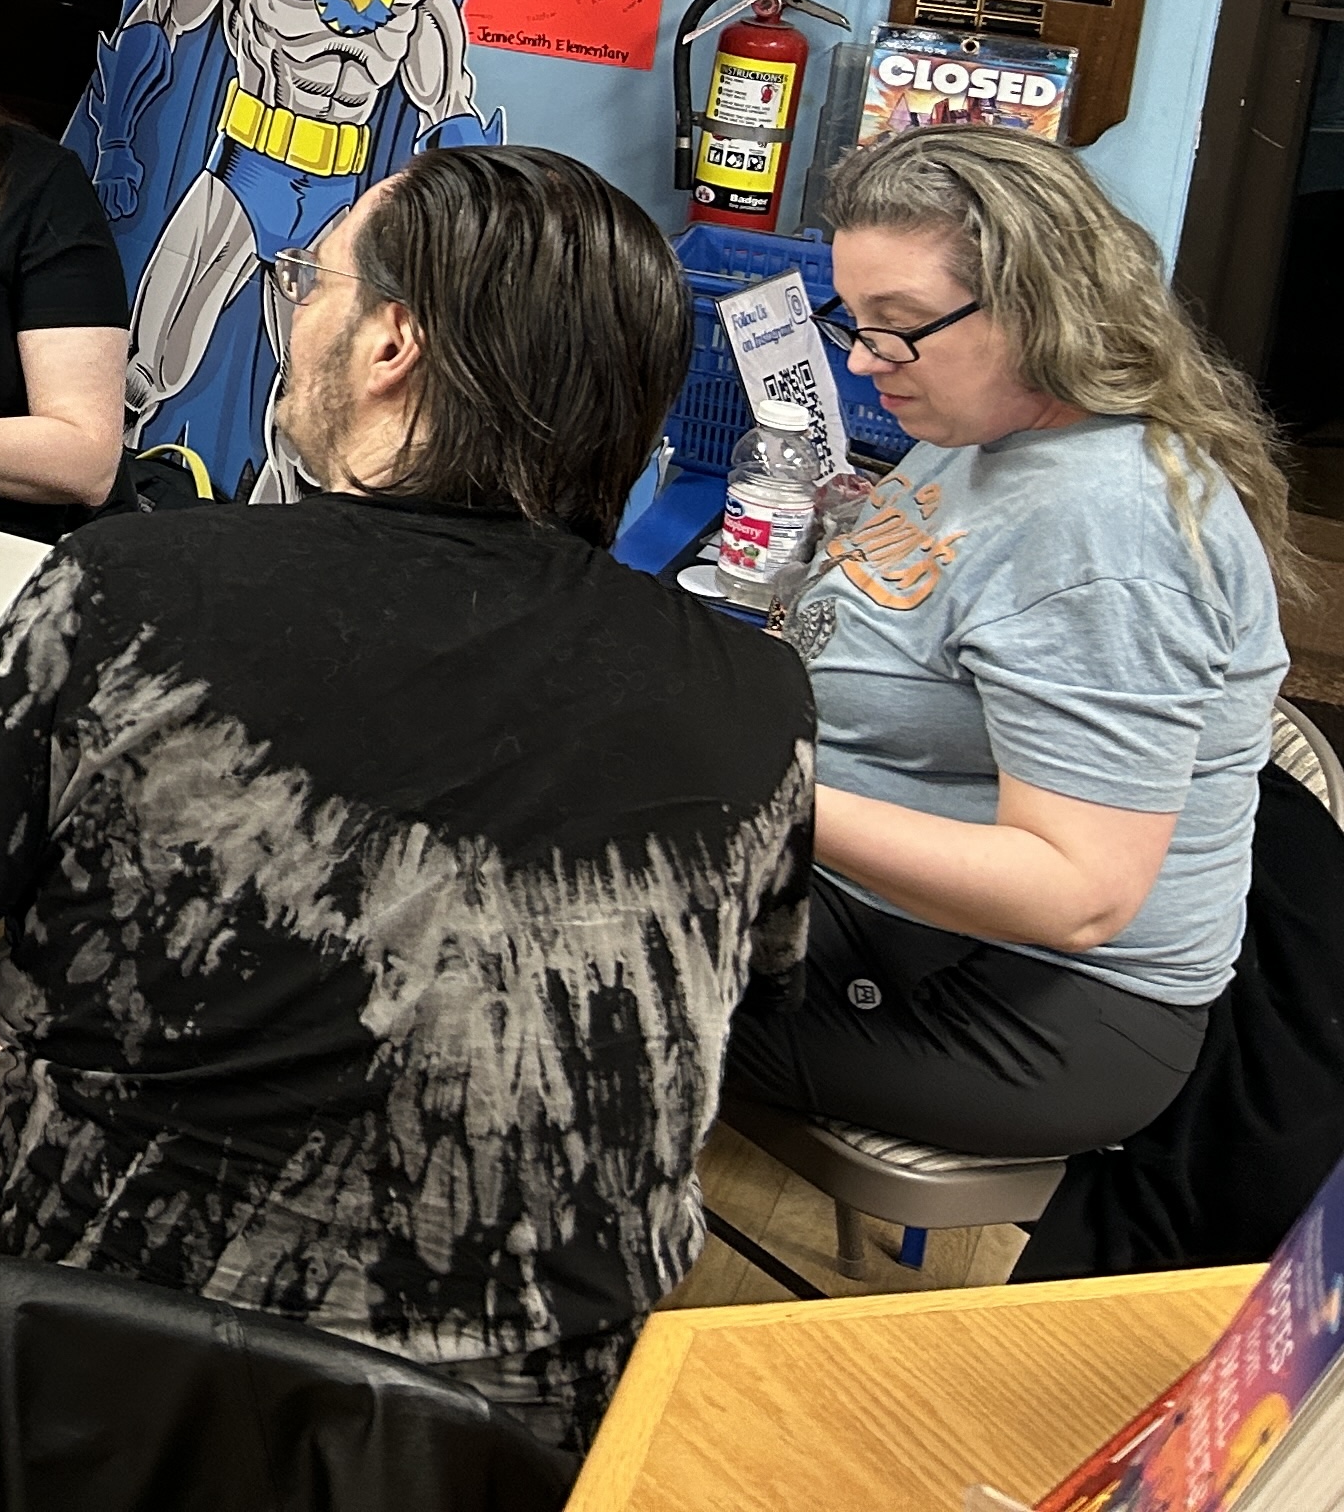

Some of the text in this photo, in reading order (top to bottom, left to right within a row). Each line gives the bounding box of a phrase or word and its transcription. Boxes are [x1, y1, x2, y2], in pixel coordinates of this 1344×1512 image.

[516, 32, 551, 50] Smith
[556, 39, 630, 63] Elementary
[877, 56, 1058, 108] CLOSED
[730, 194, 768, 206] Badger
